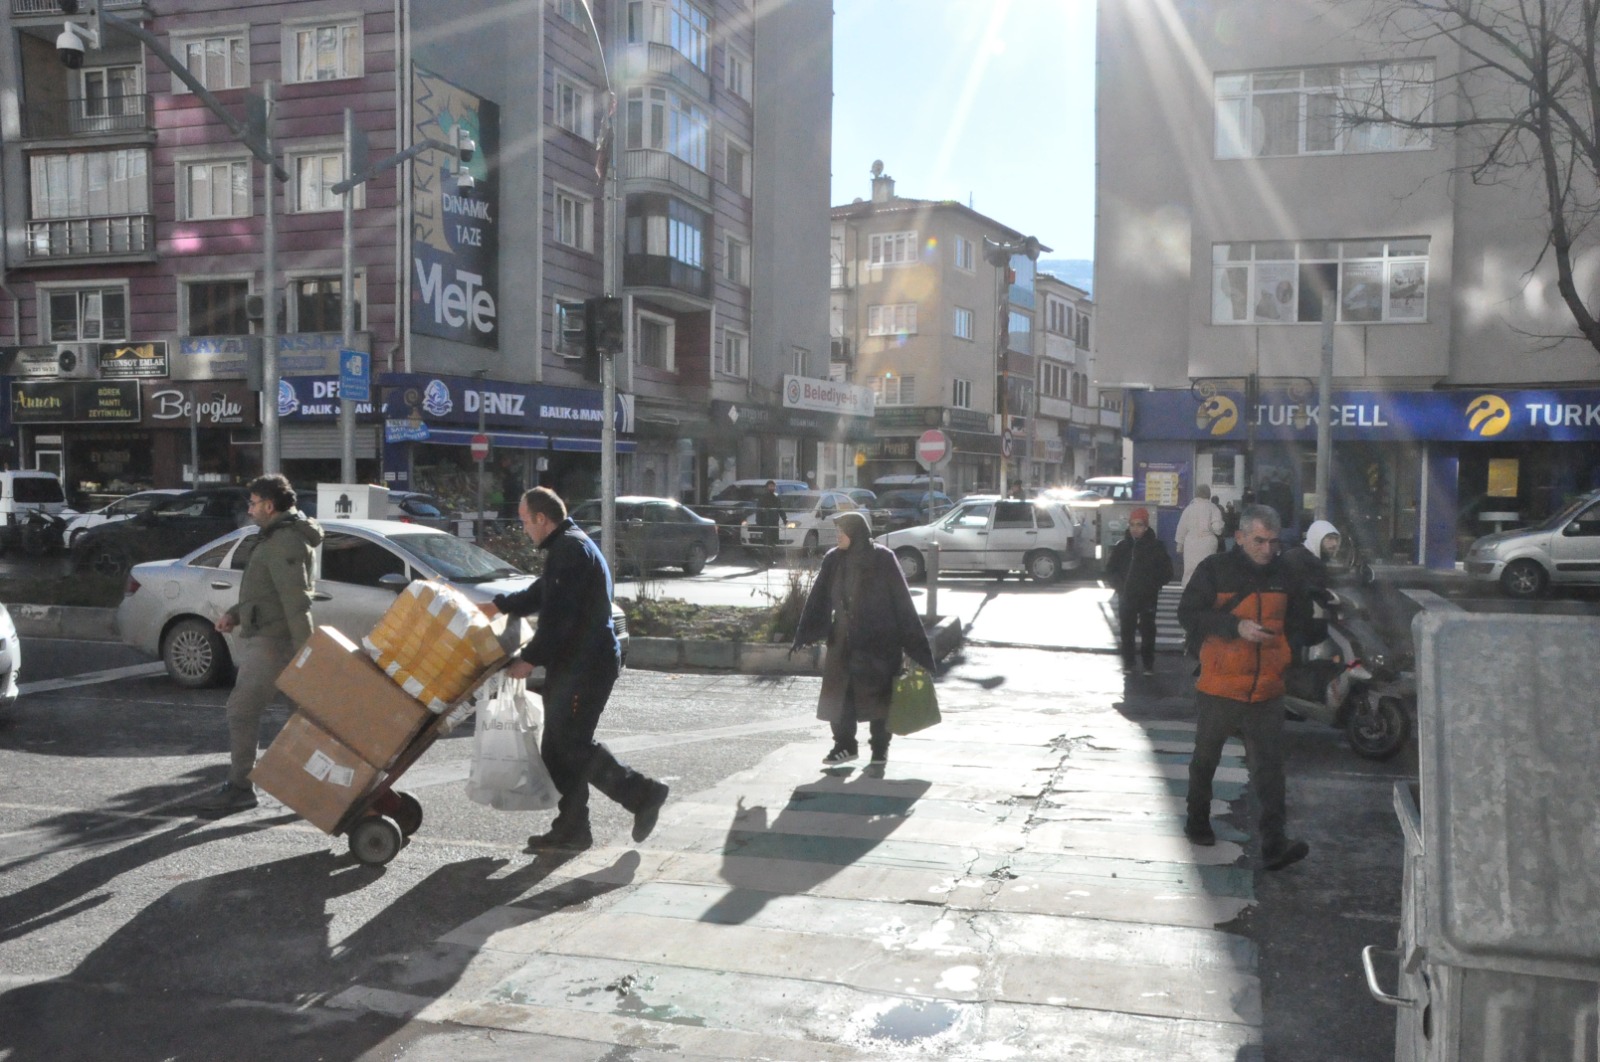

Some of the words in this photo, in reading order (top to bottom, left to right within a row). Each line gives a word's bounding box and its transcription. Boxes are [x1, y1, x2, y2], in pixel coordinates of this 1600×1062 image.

[456, 225, 482, 247] TAZE
[139, 359, 165, 367] EMLAK
[301, 404, 332, 415] BALIK
[540, 405, 571, 420] BALIK
[571, 409, 579, 420] &
[1525, 403, 1600, 426] TURK
